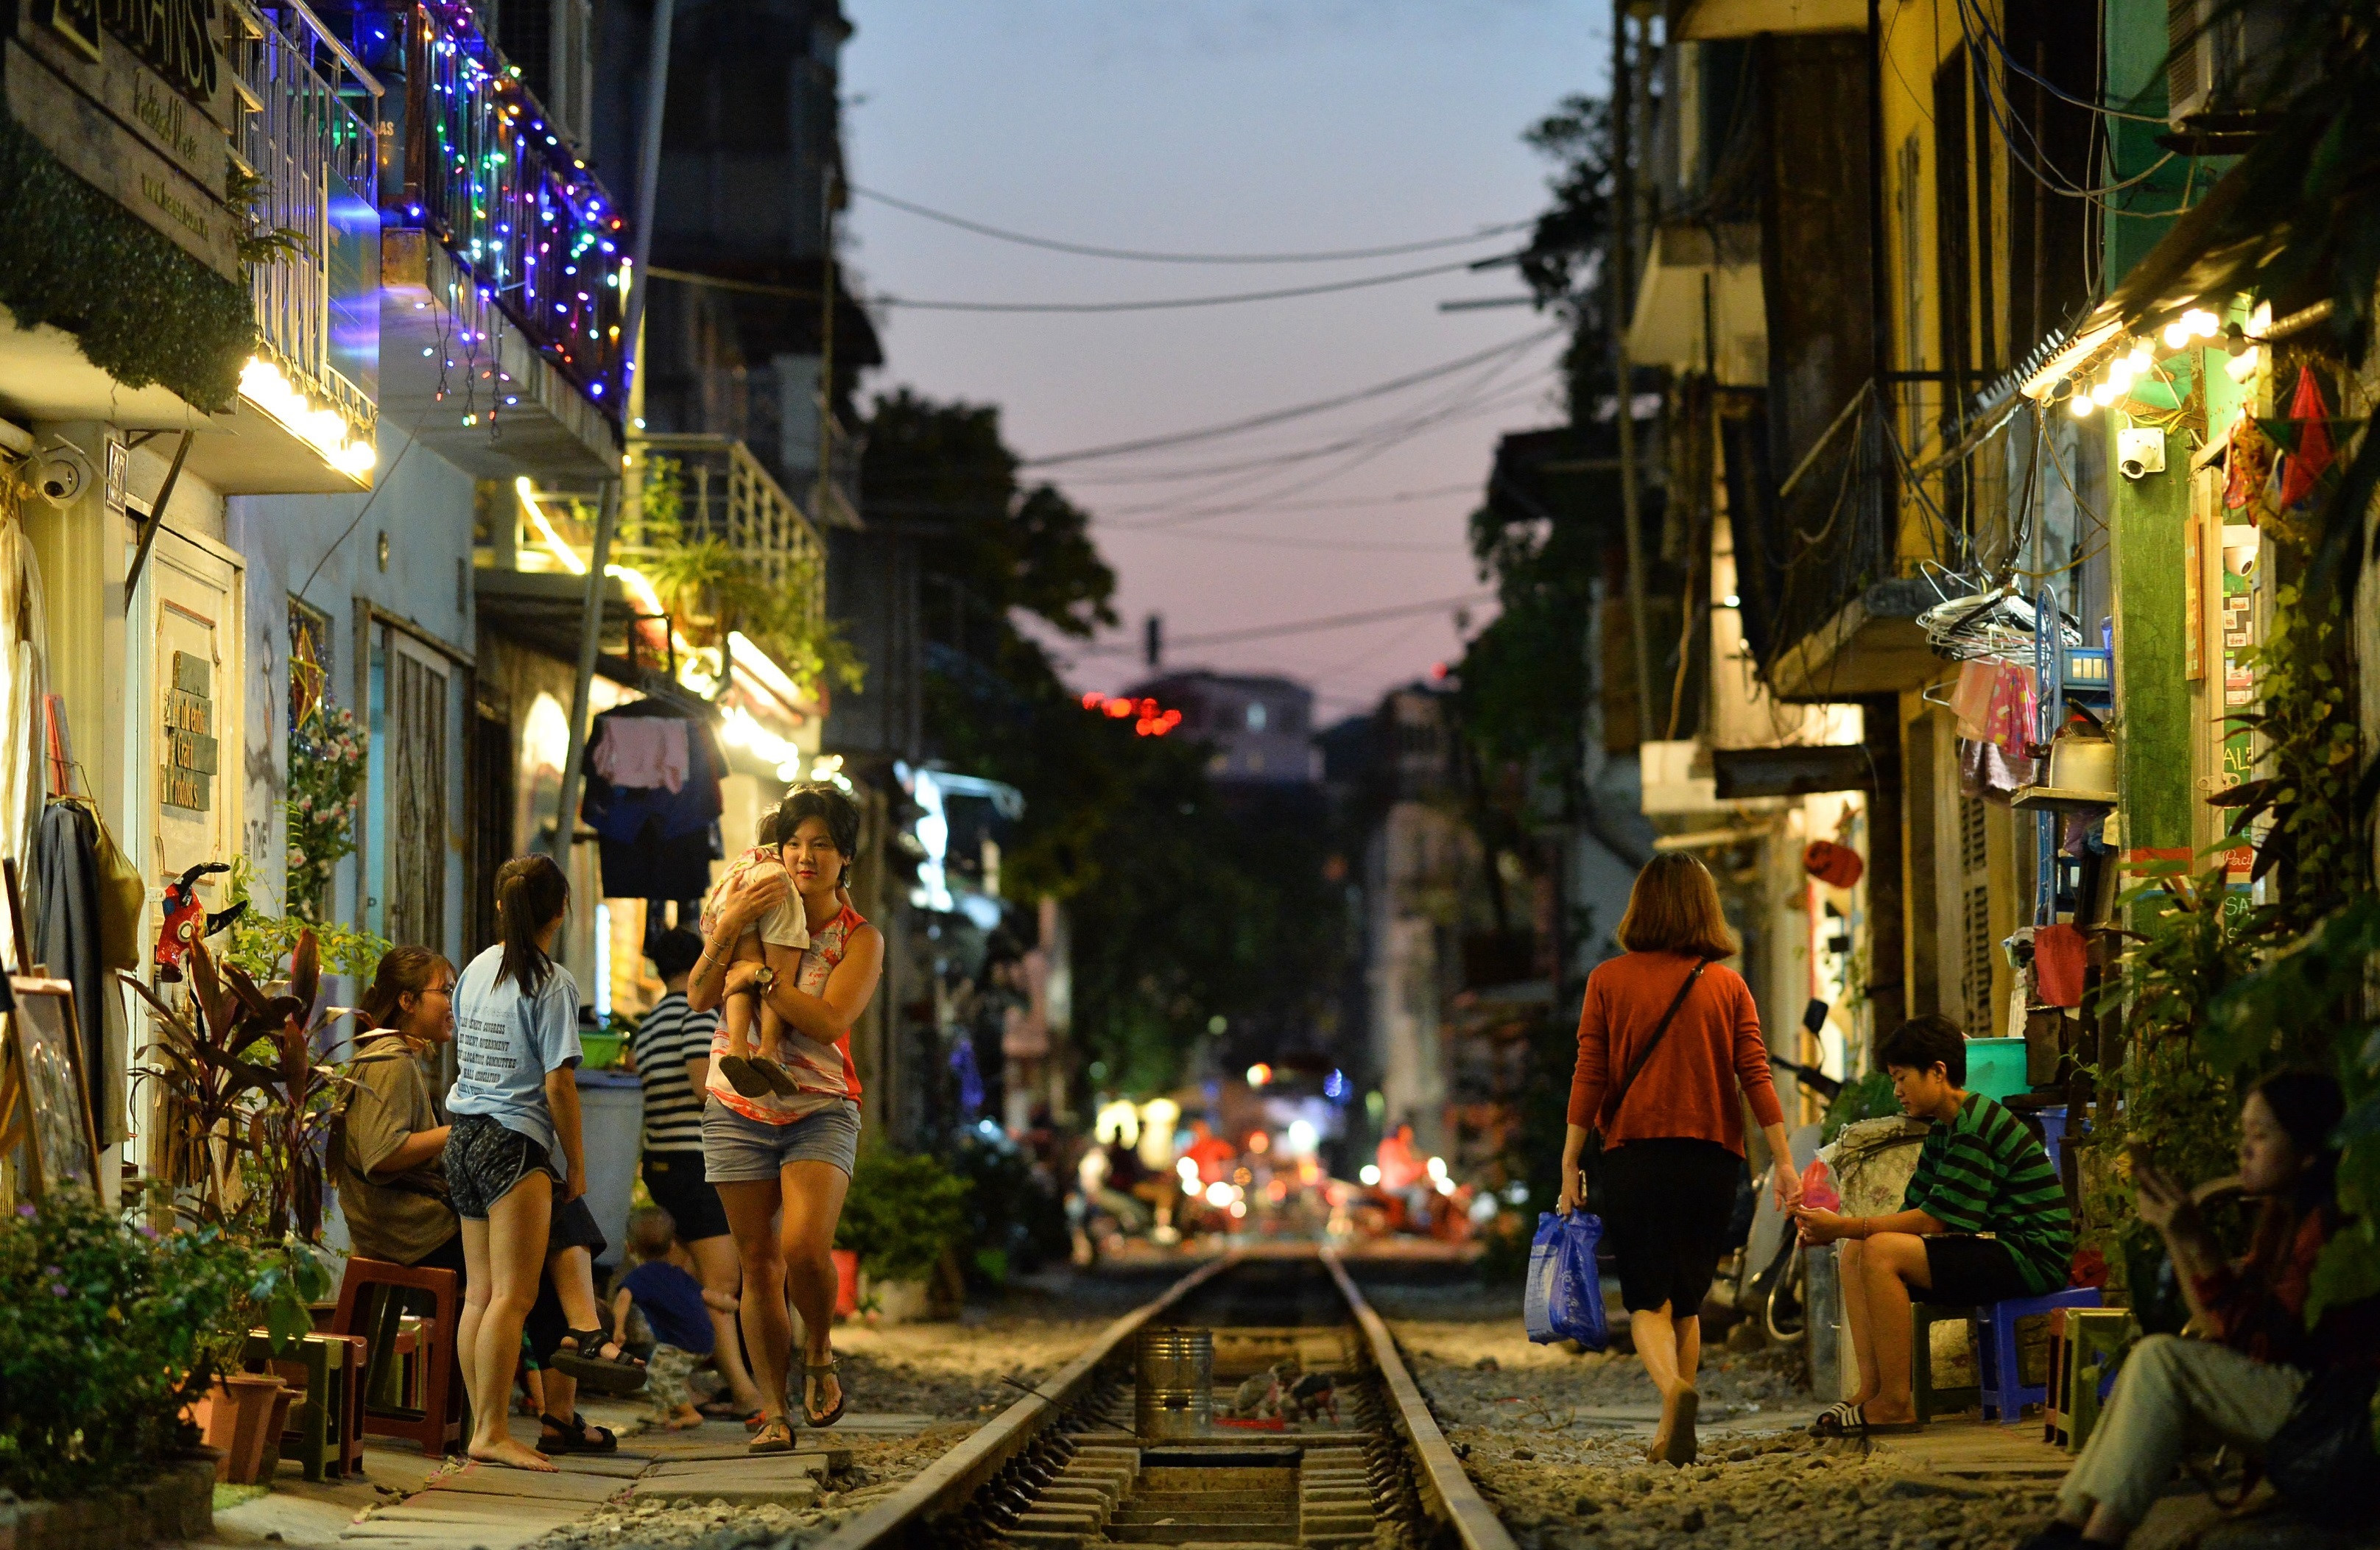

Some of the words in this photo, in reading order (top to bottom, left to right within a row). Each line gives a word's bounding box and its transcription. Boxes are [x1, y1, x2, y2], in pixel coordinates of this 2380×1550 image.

[379, 121, 395, 136] AS
[177, 732, 194, 769] Craft
[2225, 896, 2252, 915] SA
[483, 1022, 506, 1035] CONGRESS
[479, 1038, 510, 1052] GOVERNMENT
[486, 1055, 517, 1069] COMMITTEE
